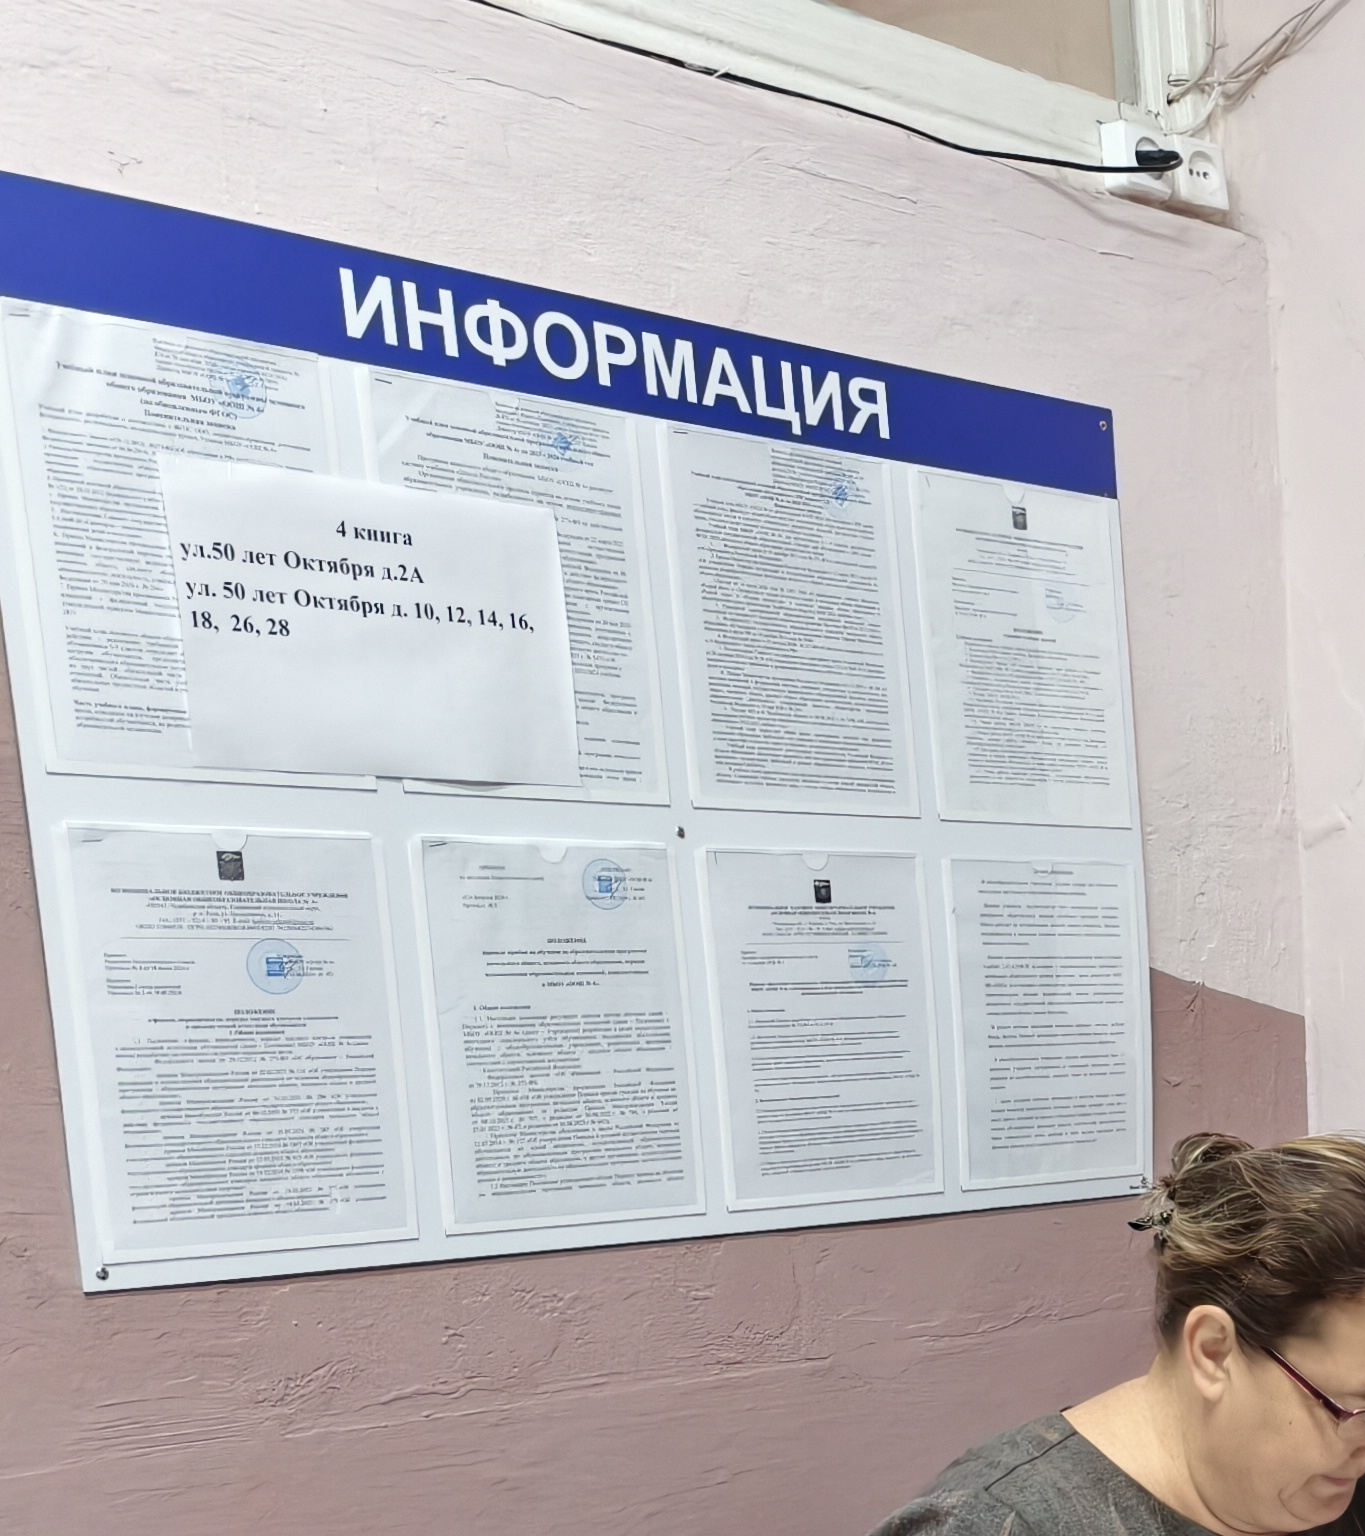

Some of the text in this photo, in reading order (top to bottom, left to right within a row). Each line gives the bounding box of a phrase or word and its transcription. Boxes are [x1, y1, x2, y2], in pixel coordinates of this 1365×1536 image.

[338, 267, 891, 439] ИНФОРМАЦИЯ
[336, 520, 413, 547] 4 книга
[180, 541, 425, 585] ул.50 лет Октября д.2А
[185, 580, 535, 634] ул. 50 лет Октября д. 10, 12, 14, 16,
[190, 610, 291, 638] 18, 26, 28
